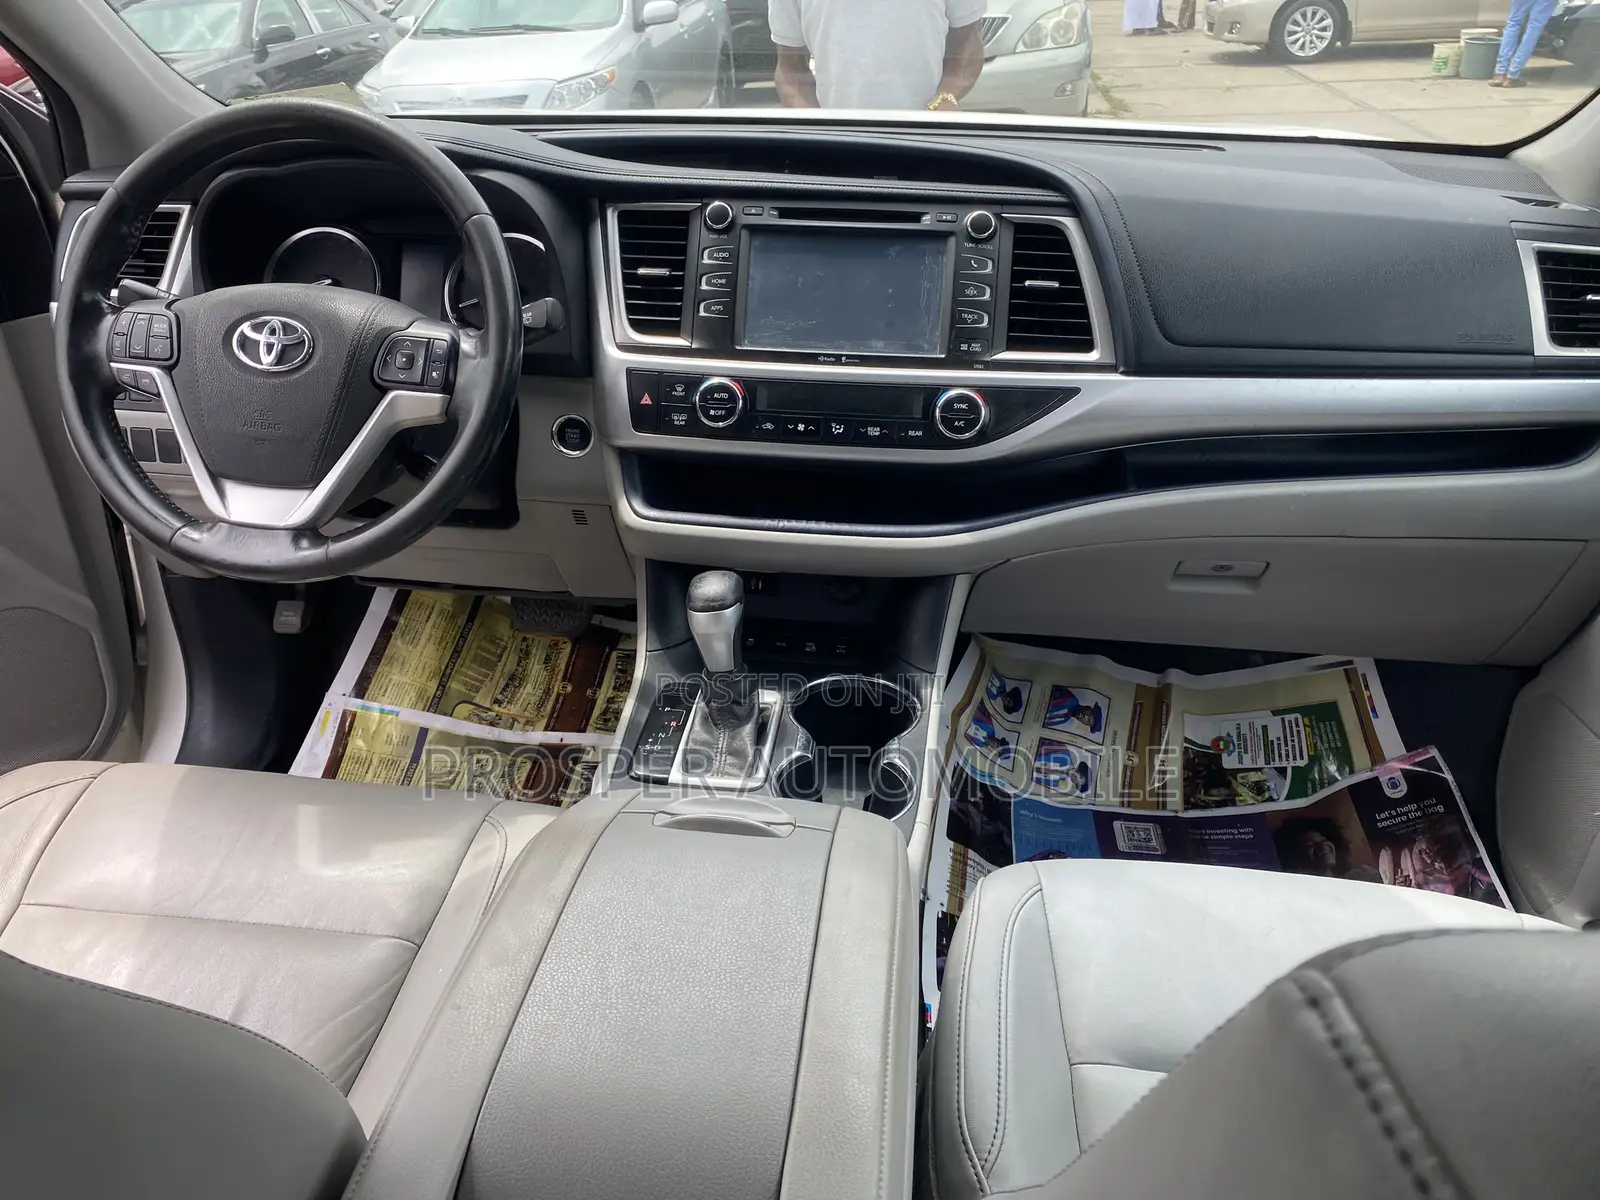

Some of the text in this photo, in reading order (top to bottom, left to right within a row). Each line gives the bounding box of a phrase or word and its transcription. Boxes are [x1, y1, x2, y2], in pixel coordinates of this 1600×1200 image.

[242, 421, 282, 432] AIRBAG
[1376, 798, 1436, 820] Let's help you
[1376, 816, 1408, 828] secure
[1408, 810, 1423, 819] the
[1424, 804, 1444, 814] bag
